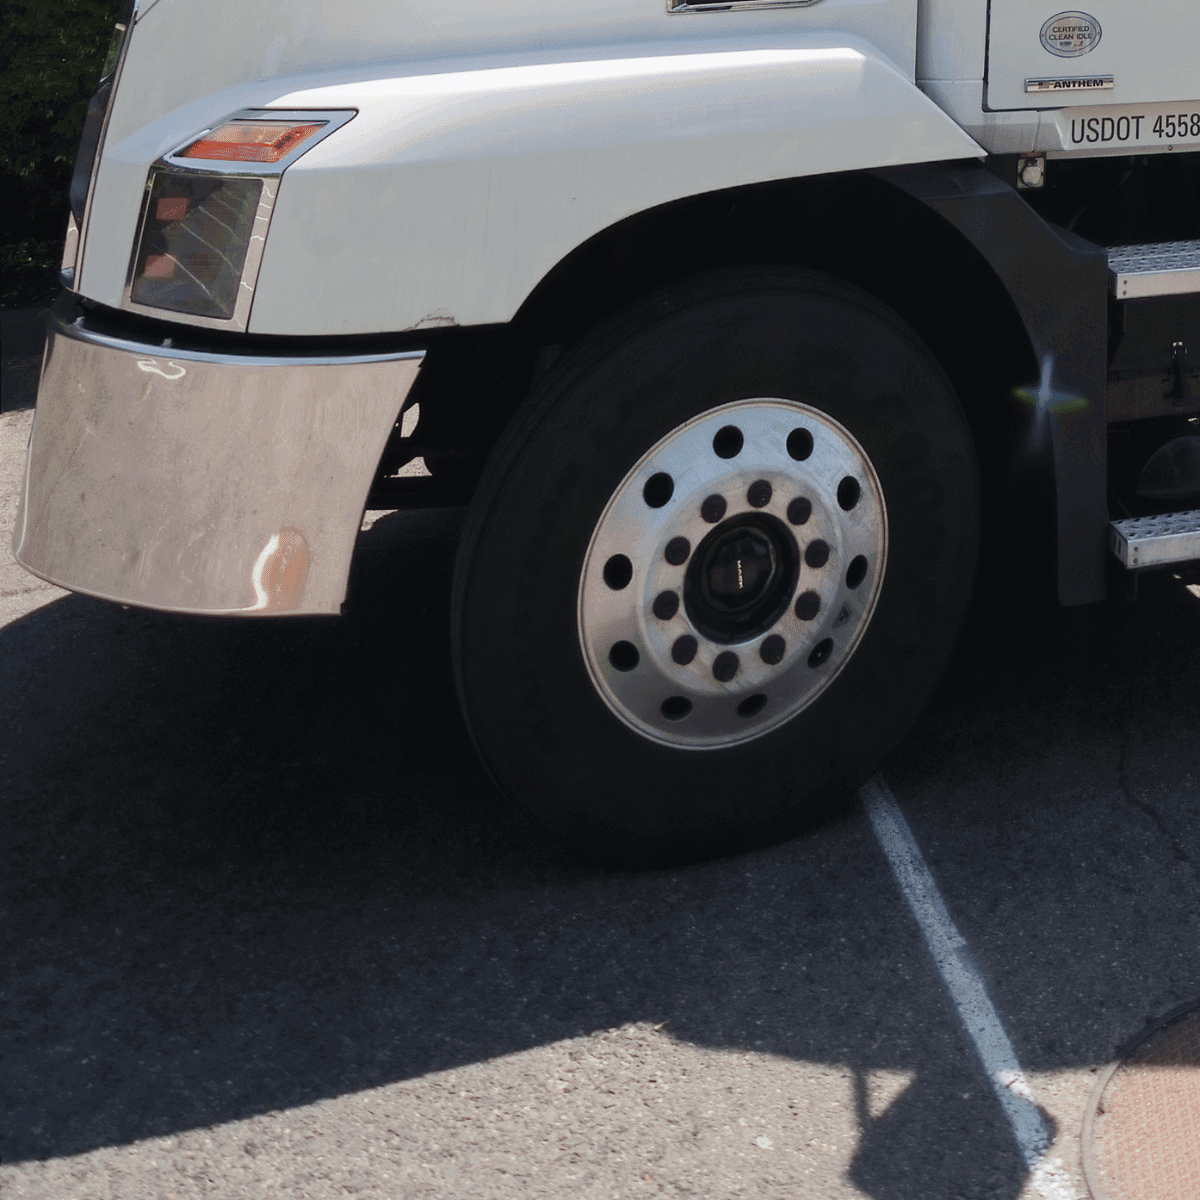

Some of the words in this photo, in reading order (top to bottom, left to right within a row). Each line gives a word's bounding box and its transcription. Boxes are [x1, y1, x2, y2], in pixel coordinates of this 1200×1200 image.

[1052, 25, 1090, 33] CERTIFIED
[1048, 33, 1074, 41] CLEAN
[1076, 32, 1093, 40] IDLE
[1053, 79, 1104, 89] ANTHEM
[1071, 115, 1145, 144] USDOT
